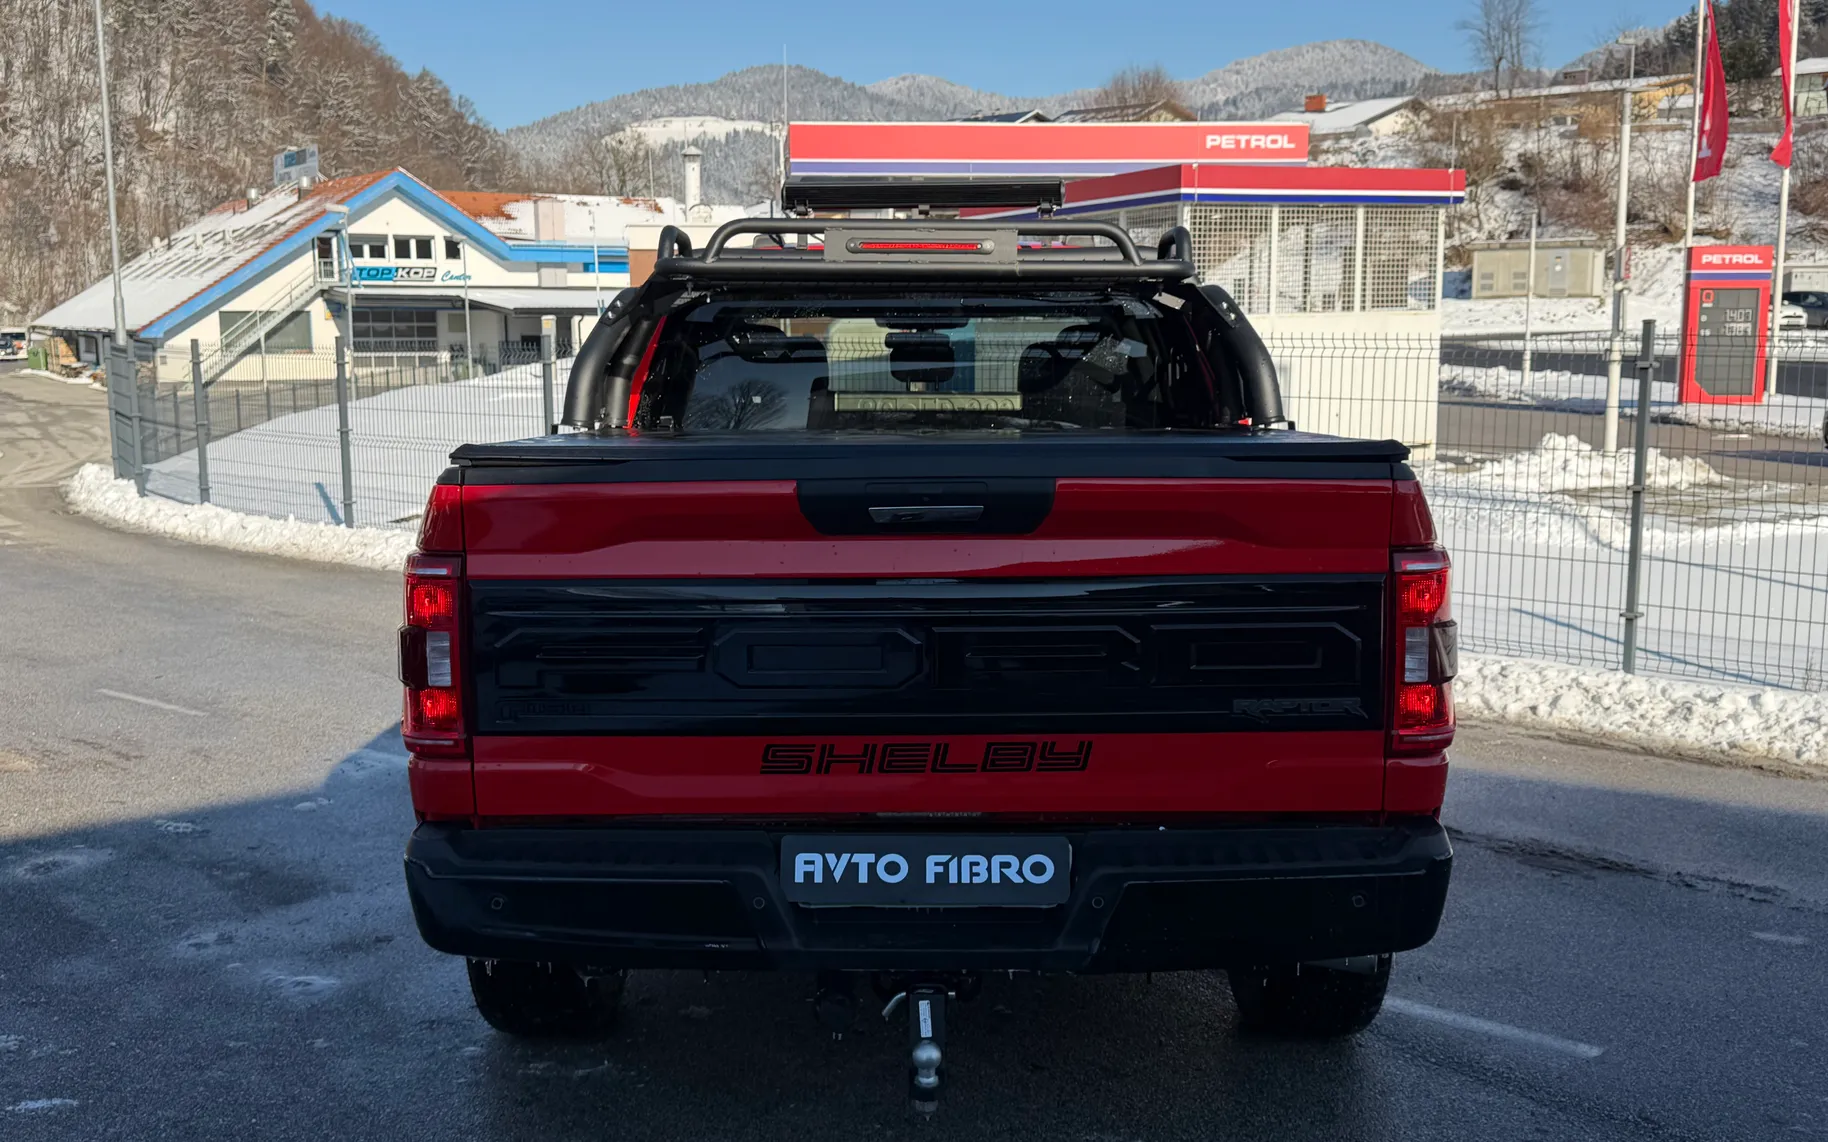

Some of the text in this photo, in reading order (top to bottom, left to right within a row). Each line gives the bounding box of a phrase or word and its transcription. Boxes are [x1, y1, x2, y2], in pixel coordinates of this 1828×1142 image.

[1206, 134, 1296, 149] PETROL
[1702, 253, 1763, 264] PETROL
[1233, 697, 1368, 720] RAPTOR
[760, 741, 1093, 775] SHELBY
[794, 852, 1055, 884] AVTO FIBRO
